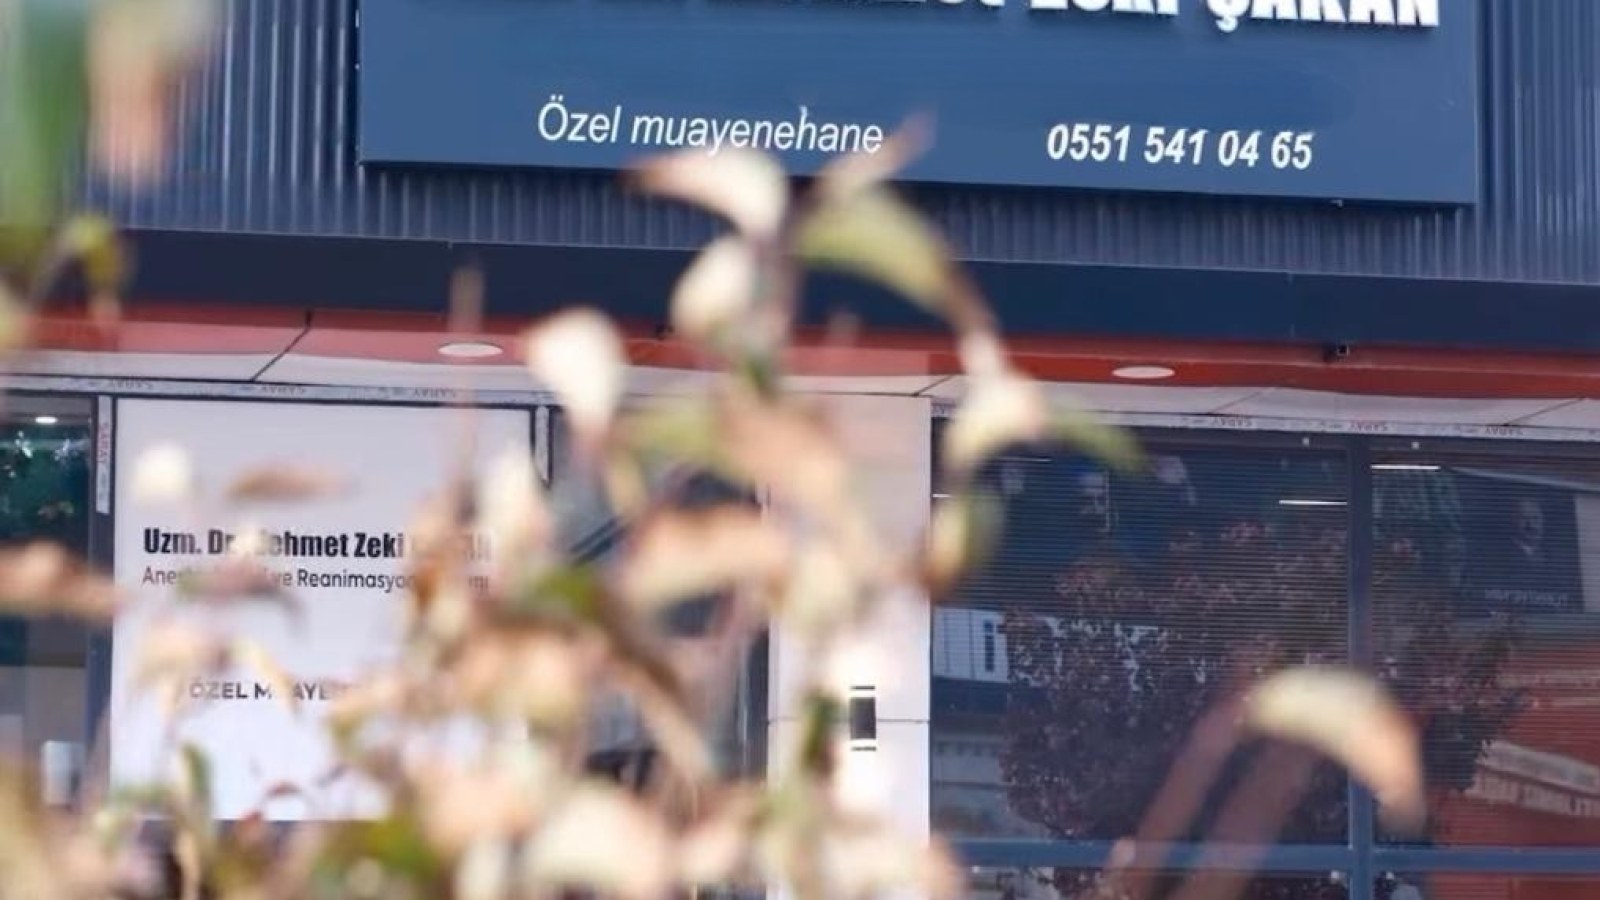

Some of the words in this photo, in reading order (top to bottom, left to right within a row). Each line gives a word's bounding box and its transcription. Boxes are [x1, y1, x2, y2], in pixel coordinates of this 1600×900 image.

[537, 94, 622, 144] Özel
[631, 105, 884, 156] muayenehane
[1047, 123, 1132, 161] 0551
[1144, 126, 1206, 165] 541
[1218, 130, 1261, 168] 04
[1271, 130, 1314, 169] 65
[144, 528, 201, 554] Uzm.
[256, 530, 349, 557] ehmet
[353, 532, 404, 558] Zeki
